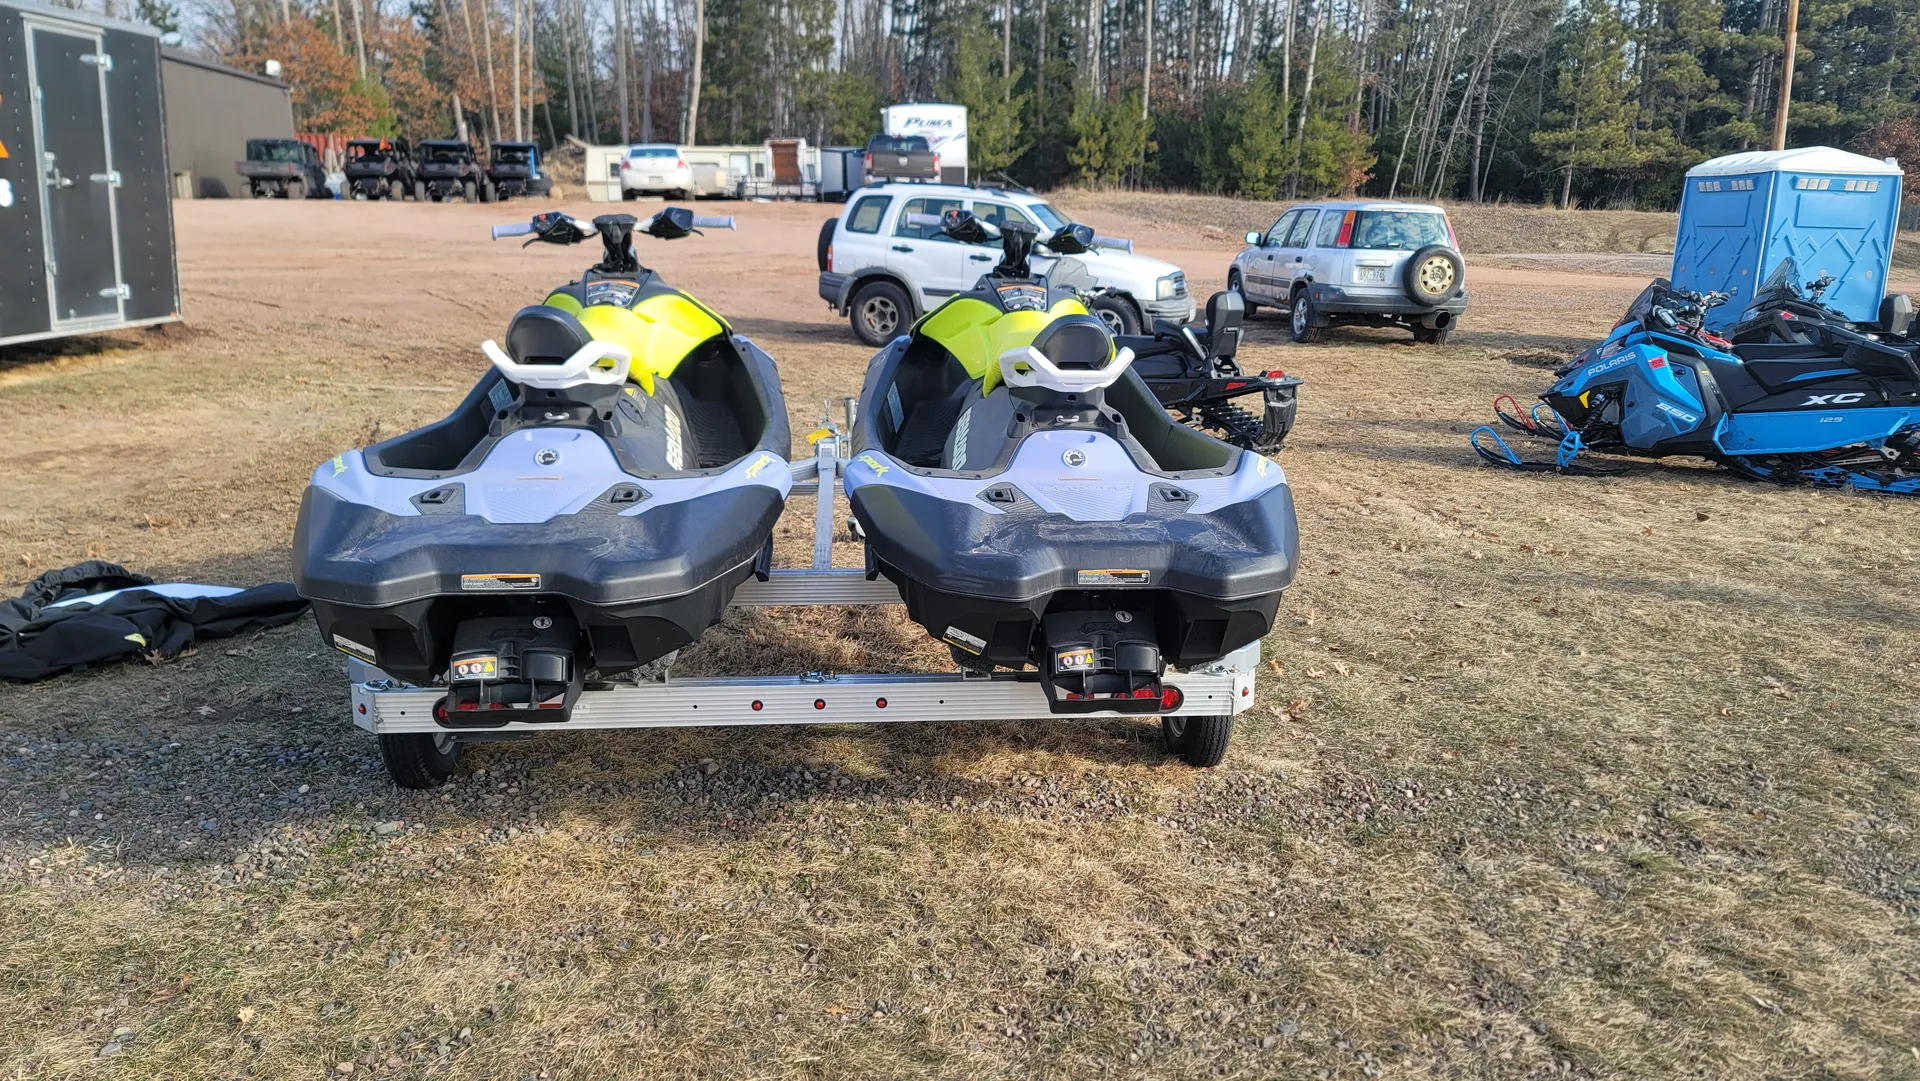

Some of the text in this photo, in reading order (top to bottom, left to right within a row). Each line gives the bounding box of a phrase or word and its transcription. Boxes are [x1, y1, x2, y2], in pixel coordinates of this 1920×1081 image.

[903, 116, 953, 128] PUMA
[1733, 315, 1775, 334] POLARIS
[1587, 351, 1637, 377] POLARIS
[1800, 392, 1866, 406] XC
[1655, 402, 1697, 423] 850
